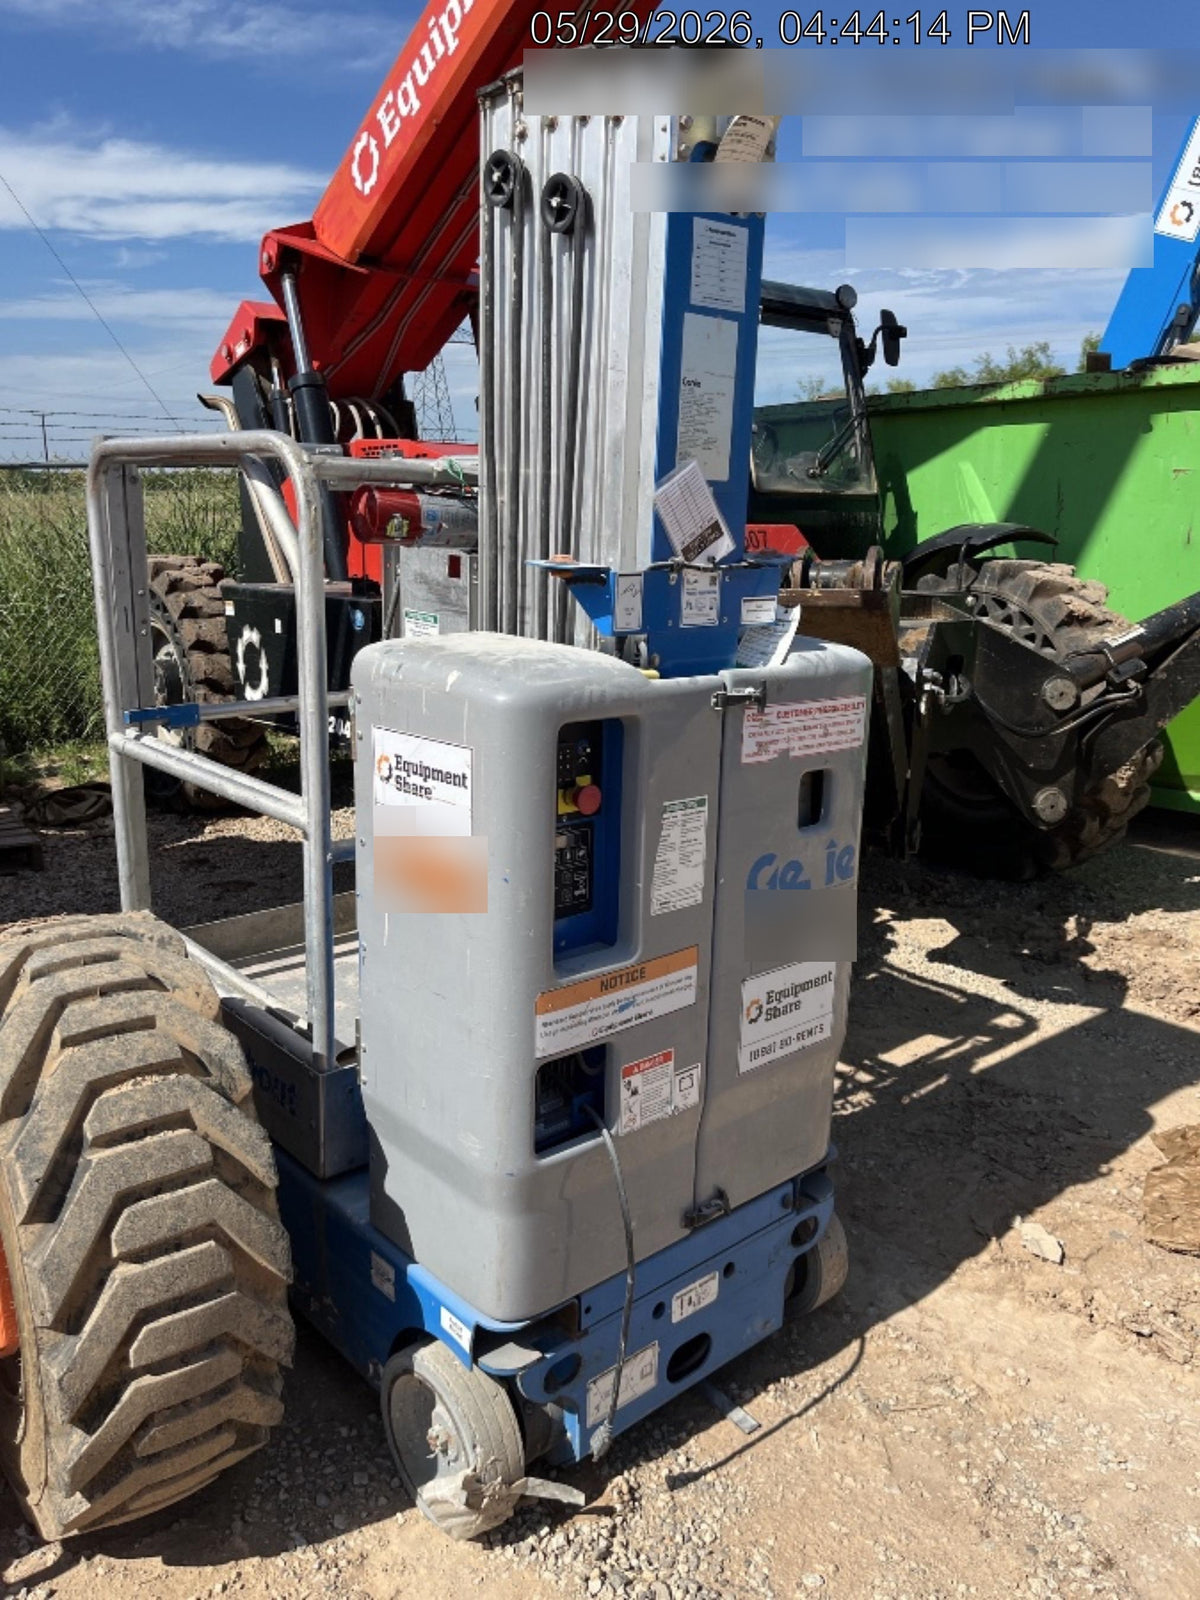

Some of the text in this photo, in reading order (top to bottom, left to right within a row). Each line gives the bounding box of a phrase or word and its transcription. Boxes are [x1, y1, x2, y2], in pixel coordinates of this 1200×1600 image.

[394, 754, 468, 790] Equipment
[395, 774, 433, 800] Share
[600, 967, 647, 992] NOTICE
[766, 970, 833, 1005] Equipment
[765, 1000, 802, 1022] Share
